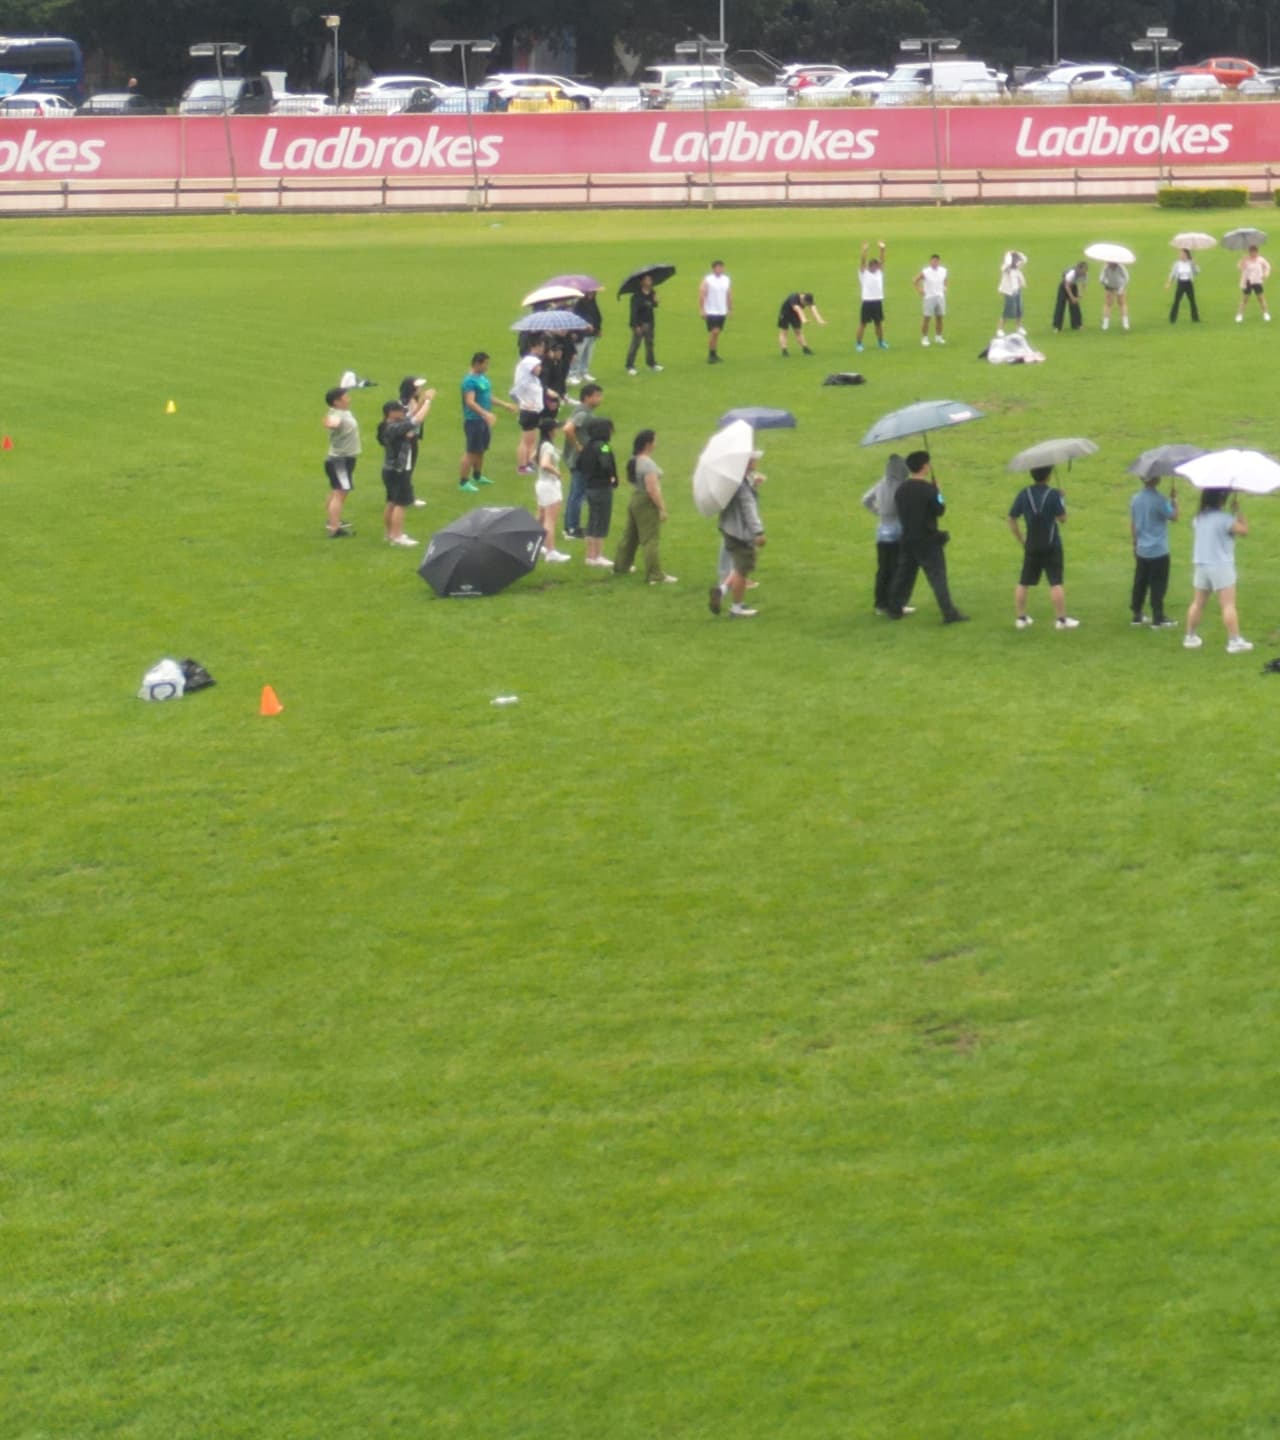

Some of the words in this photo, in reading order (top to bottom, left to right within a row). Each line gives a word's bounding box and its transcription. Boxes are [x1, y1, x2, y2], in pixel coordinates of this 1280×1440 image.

[259, 125, 504, 170] Ladbrokes
[649, 120, 879, 163] Ladbrokes
[1015, 115, 1233, 158] Ladbrokes
